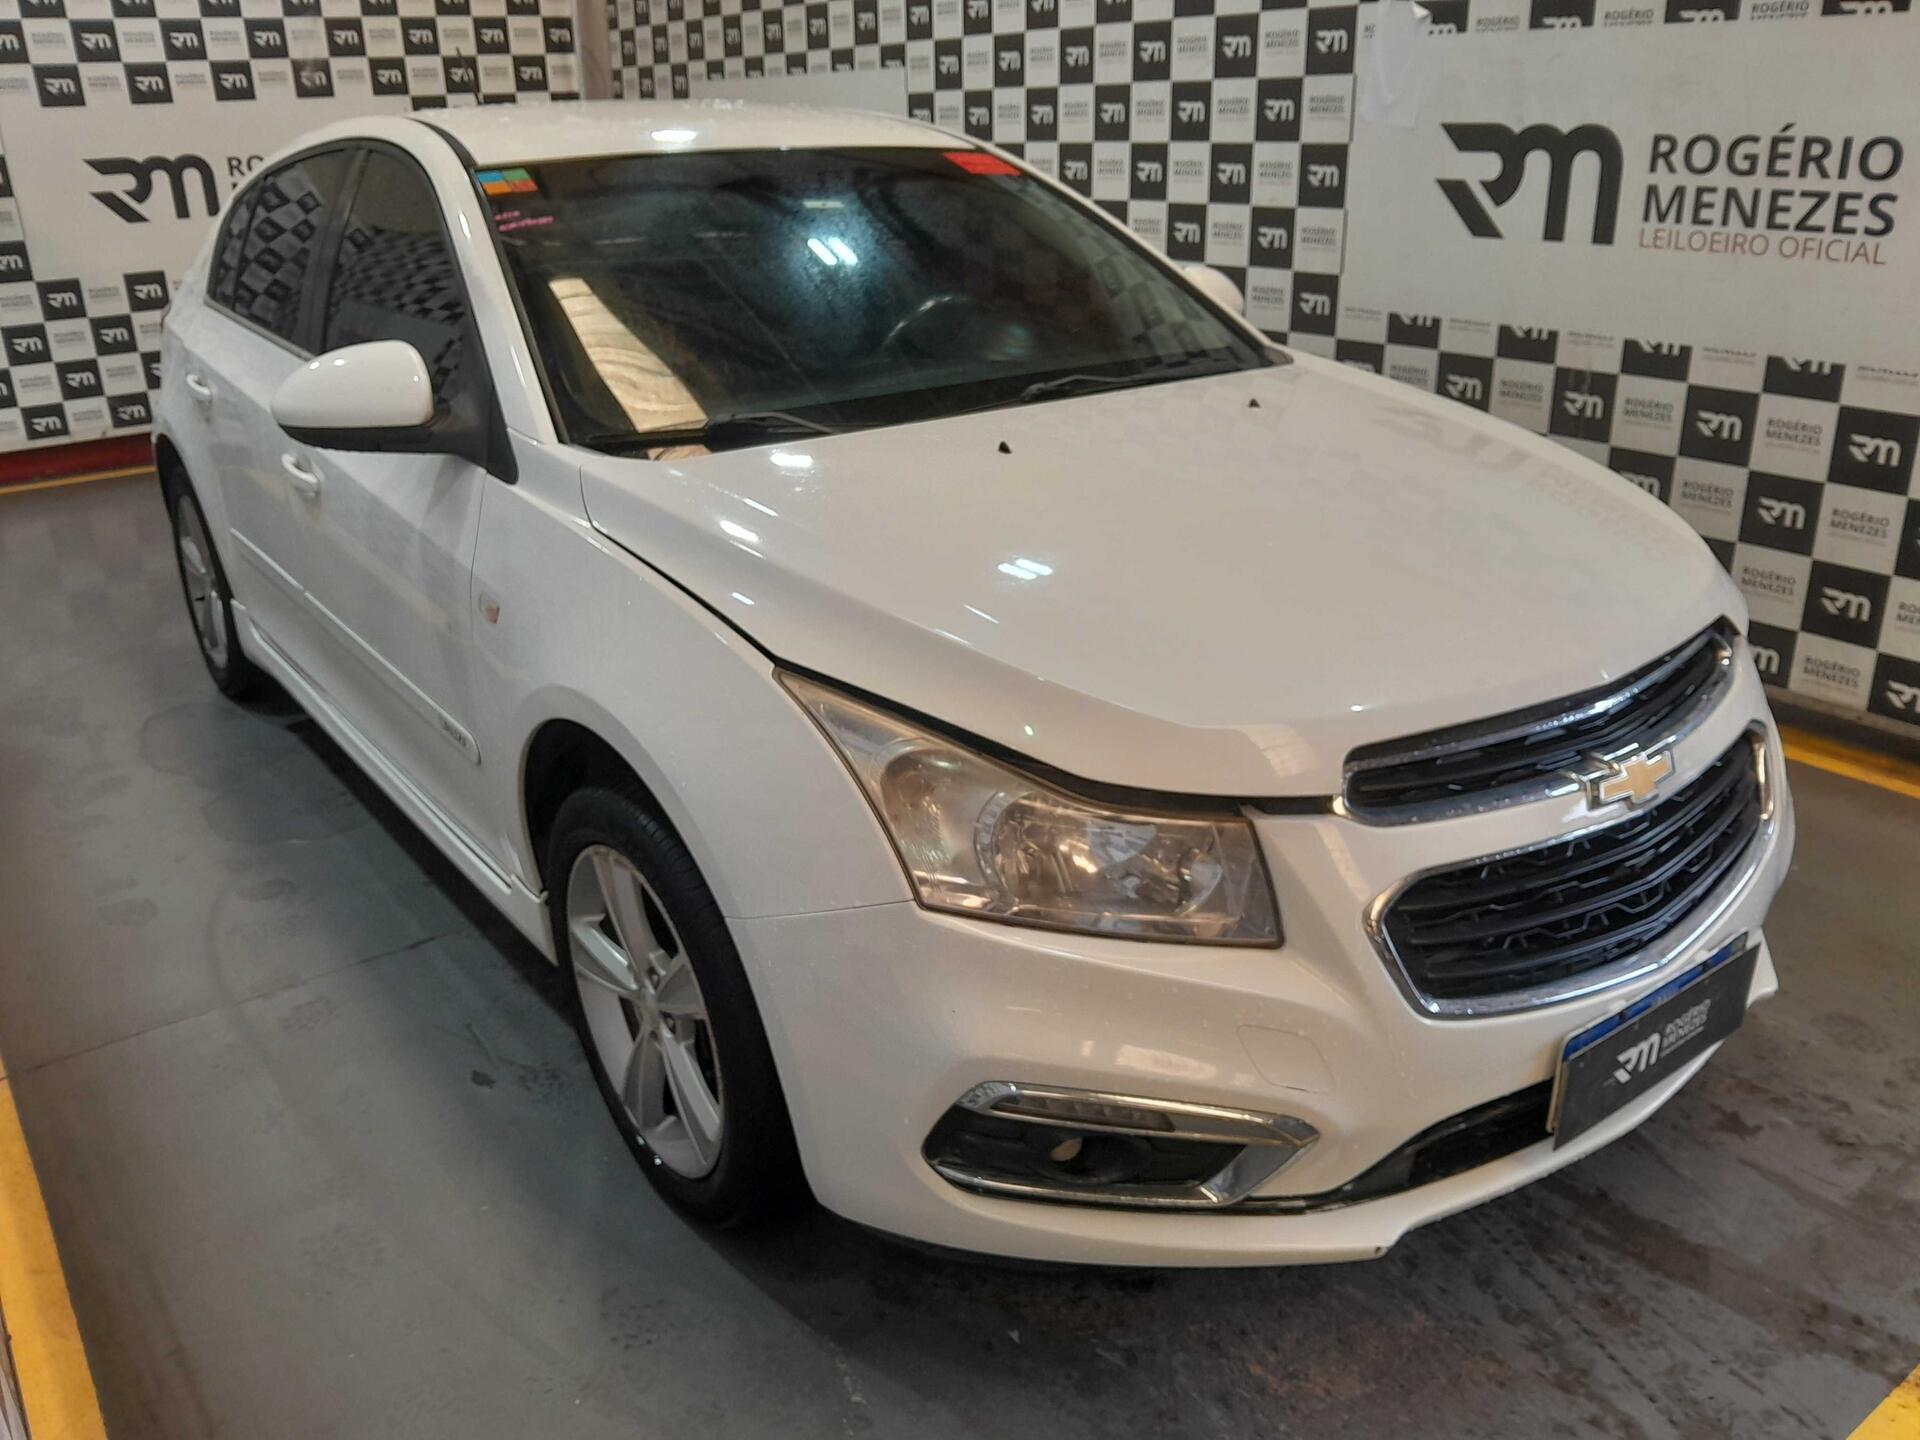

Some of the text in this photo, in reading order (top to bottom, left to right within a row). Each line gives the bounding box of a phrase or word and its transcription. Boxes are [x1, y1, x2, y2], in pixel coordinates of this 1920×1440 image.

[1648, 123, 1905, 181] ROGÉRIO
[83, 154, 220, 223] RM
[1435, 123, 1624, 245] RM
[1642, 184, 1898, 237] MENEZES
[1638, 228, 1886, 264] LEILOEIRO OFICIAL
[48, 292, 77, 307] RM
[134, 284, 162, 299] RM
[13, 337, 42, 353] RM
[100, 328, 129, 343] RM
[66, 372, 95, 387] RM
[1446, 375, 1482, 400] RM
[1564, 391, 1603, 418] RM
[1697, 411, 1742, 440] RM
[1767, 415, 1823, 434] ROGÉRIO
[1765, 429, 1821, 447] MENEZES
[1848, 433, 1902, 467] RM
[1682, 479, 1734, 497] ROGÉRIO
[1680, 490, 1732, 509] MENEZES
[1758, 498, 1805, 529] RM
[1832, 506, 1890, 527] ROGÉRIO
[1829, 519, 1887, 539] MENEZES
[1741, 577, 1794, 596] MENEZES
[1744, 566, 1796, 585] ROGÉRIO
[1821, 587, 1871, 621] RM
[1750, 645, 1780, 675] M
[1806, 655, 1860, 677] ROGÉRIO
[1804, 665, 1858, 687] MENEZES
[1613, 1032, 1661, 1084] RM
